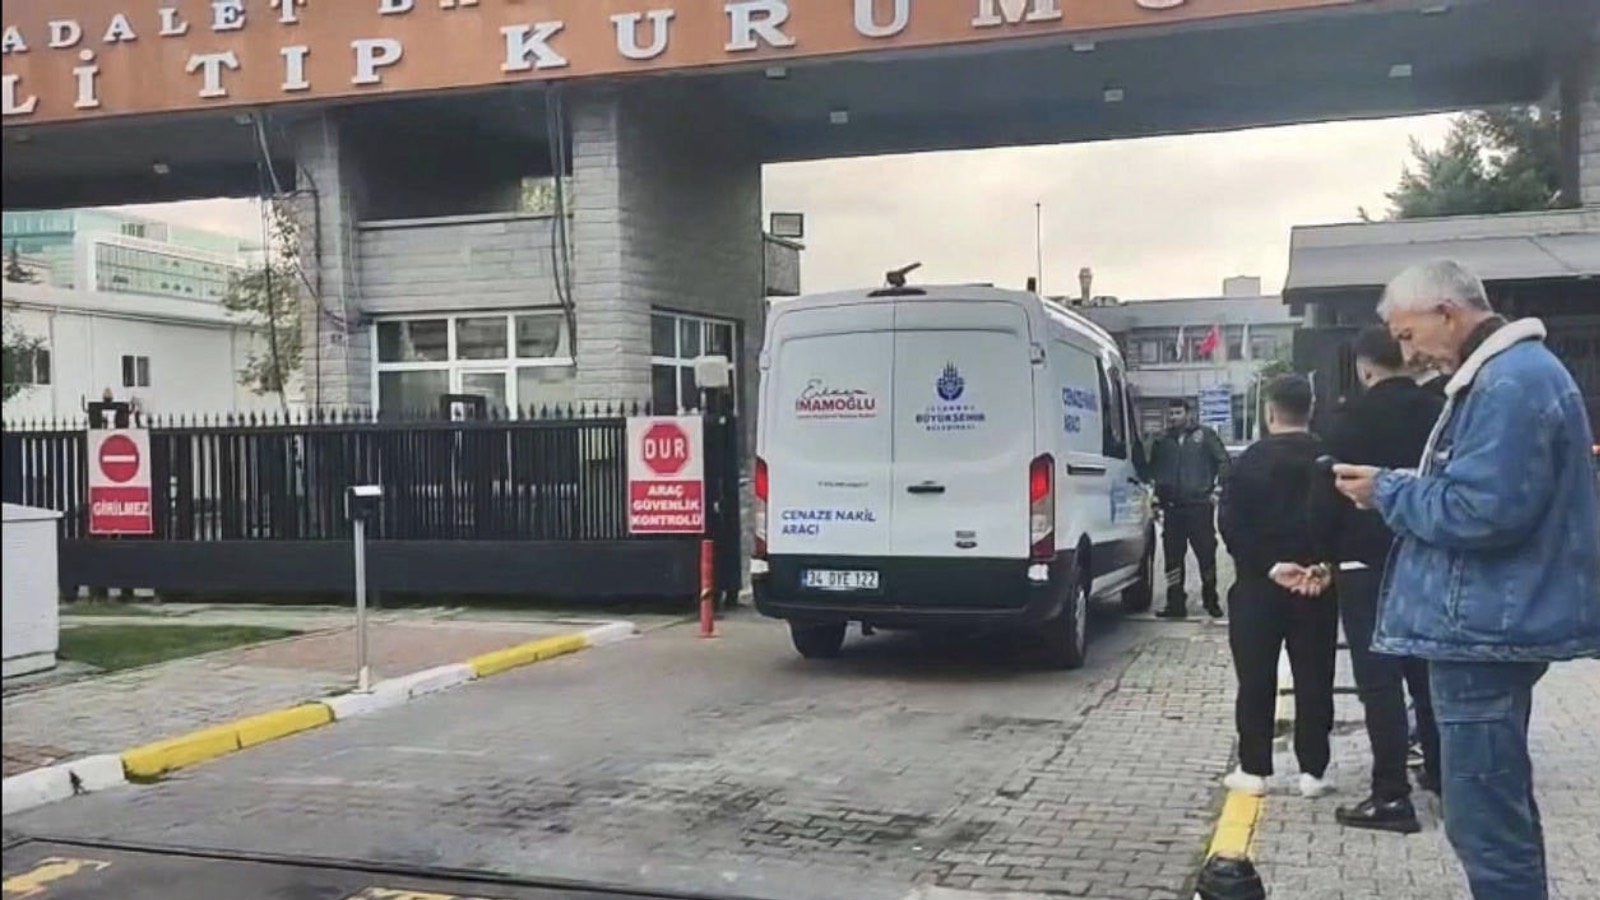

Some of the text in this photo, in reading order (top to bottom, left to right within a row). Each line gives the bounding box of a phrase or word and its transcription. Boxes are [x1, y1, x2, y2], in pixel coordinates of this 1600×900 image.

[2, 0, 306, 53] ADALET
[185, 38, 402, 98] TIP
[500, 0, 1185, 72] KURUM
[645, 438, 686, 460] DUR
[647, 485, 683, 498] ARAÇ
[781, 507, 877, 522] CENAZE NAKİL
[782, 524, 820, 536] ARACI
[808, 570, 823, 586] 34
[856, 571, 877, 587] 122
